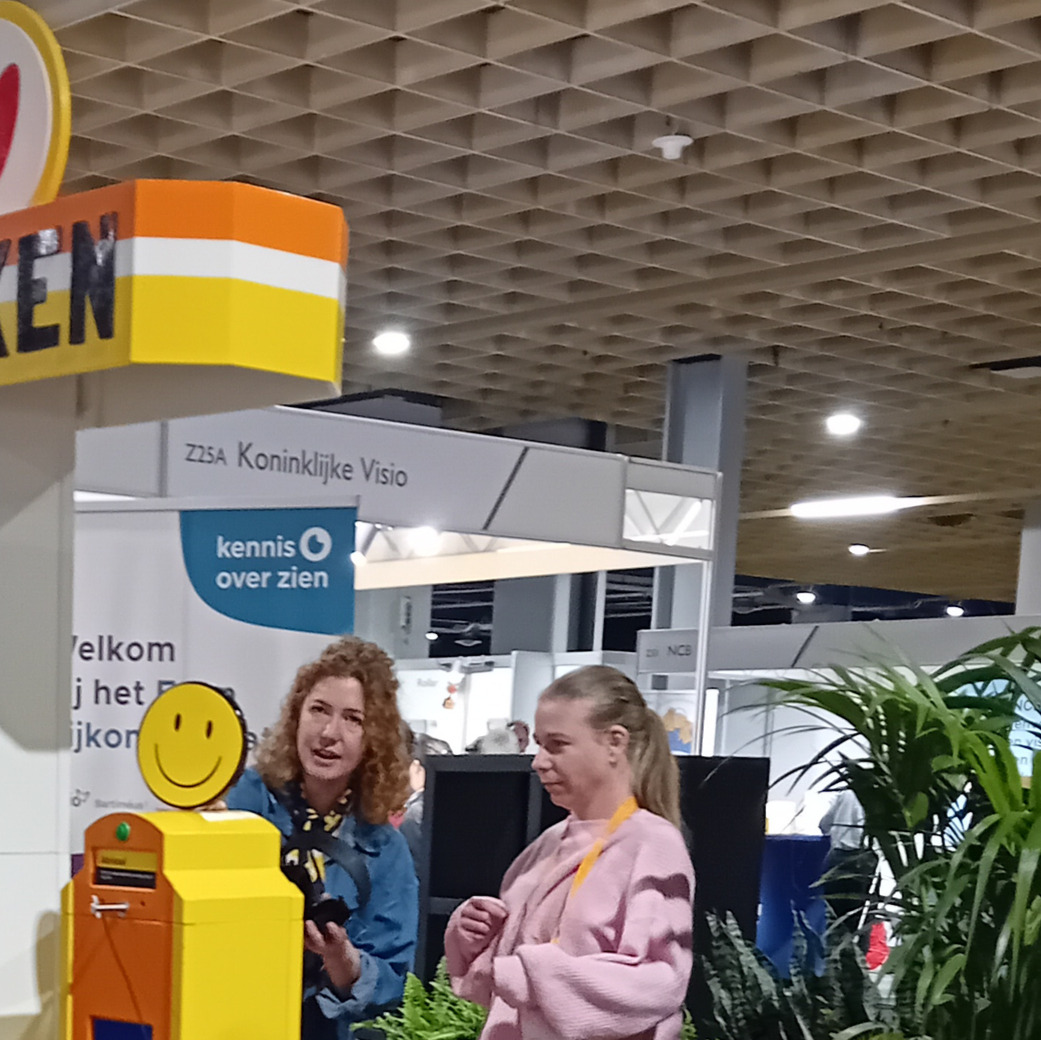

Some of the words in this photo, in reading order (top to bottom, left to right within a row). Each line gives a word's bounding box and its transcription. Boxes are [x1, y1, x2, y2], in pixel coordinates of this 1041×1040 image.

[185, 443, 227, 466] Z25A
[238, 441, 354, 485] Koninklijke
[360, 457, 409, 488] Visio
[216, 534, 296, 558] kennis
[215, 571, 272, 589] over
[277, 565, 329, 588] zien
[94, 679, 145, 707] het
